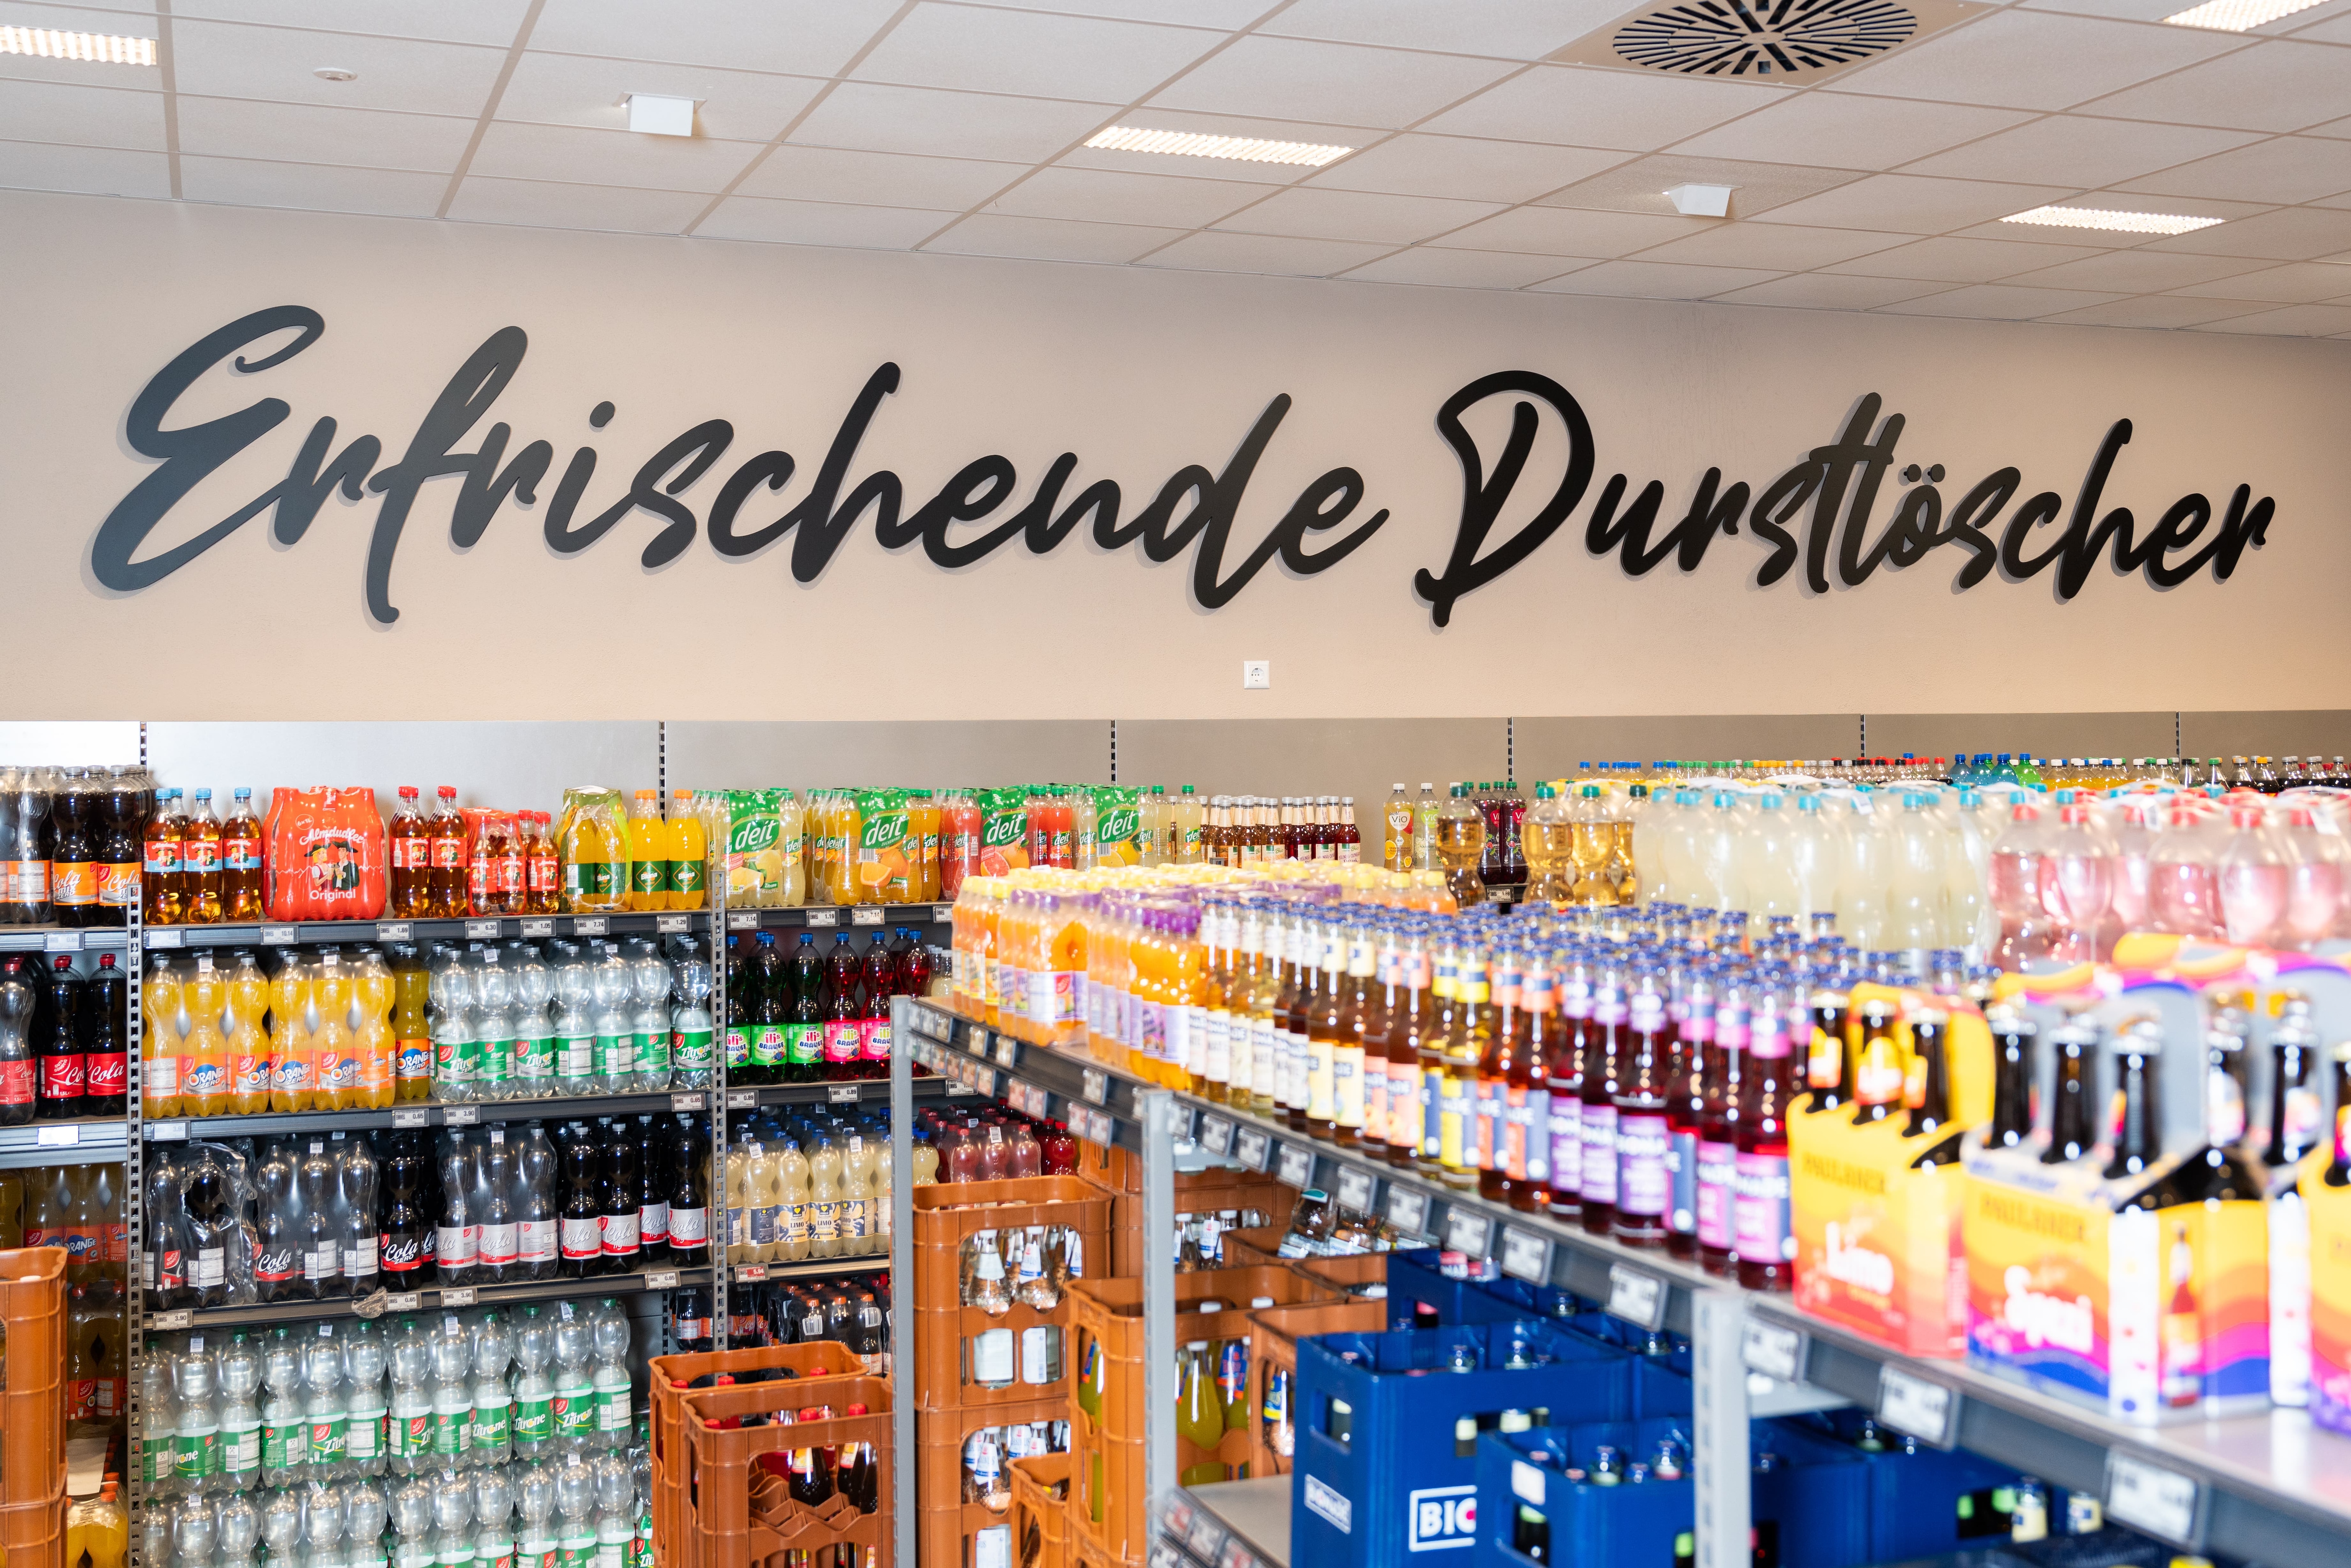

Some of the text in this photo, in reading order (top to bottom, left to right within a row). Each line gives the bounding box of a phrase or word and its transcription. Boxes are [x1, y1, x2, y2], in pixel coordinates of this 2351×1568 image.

[90, 305, 2276, 627] Erfrischende Durstlöscher
[755, 792, 766, 805] deit
[994, 794, 1003, 805] deit
[1115, 789, 1125, 801] deit
[876, 797, 886, 809] deit
[866, 816, 907, 846] deit
[986, 814, 1026, 843] deit
[1102, 811, 1136, 840] deit
[299, 826, 365, 846] Almdudler
[735, 819, 776, 850] deit
[881, 835, 901, 846] ZUCKERFREI
[1002, 833, 1019, 844] ZUCKERFREI
[1054, 834, 1070, 846] deit
[1081, 832, 1097, 844] deit
[1116, 830, 1133, 840] ZUCKERFREI
[1189, 830, 1200, 842] deit
[152, 841, 178, 850] Almdudler
[788, 840, 801, 851] deit
[925, 835, 939, 847] deit
[54, 870, 81, 890] Cola
[309, 890, 356, 902] Original
[681, 1042, 712, 1060] Zitrone
[396, 1051, 429, 1070] ORANGE
[691, 1053, 707, 1062] ZERO
[407, 1062, 425, 1072] ZERO
[460, 1064, 474, 1074] ZERO
[536, 1060, 551, 1069] ZERO
[90, 1061, 125, 1084] Cola
[189, 1066, 225, 1087] ORANGE
[275, 1064, 310, 1083] ORANGE
[201, 1078, 220, 1088] ZERO
[287, 1075, 306, 1085] ZERO
[671, 1216, 700, 1236] Cola
[563, 1226, 592, 1246] Cola
[605, 1222, 636, 1243] Cola
[677, 1232, 694, 1243] light
[481, 1231, 512, 1252] Cola
[613, 1239, 631, 1251] light
[386, 1239, 418, 1262] Cola
[568, 1243, 585, 1253] light
[259, 1249, 292, 1272] Cola
[394, 1254, 414, 1265] ZERO
[268, 1263, 287, 1275] ZERO
[80, 1382, 91, 1395] GÜNSTIG
[473, 1418, 505, 1435] Zitrone
[515, 1413, 545, 1430] Zitrone
